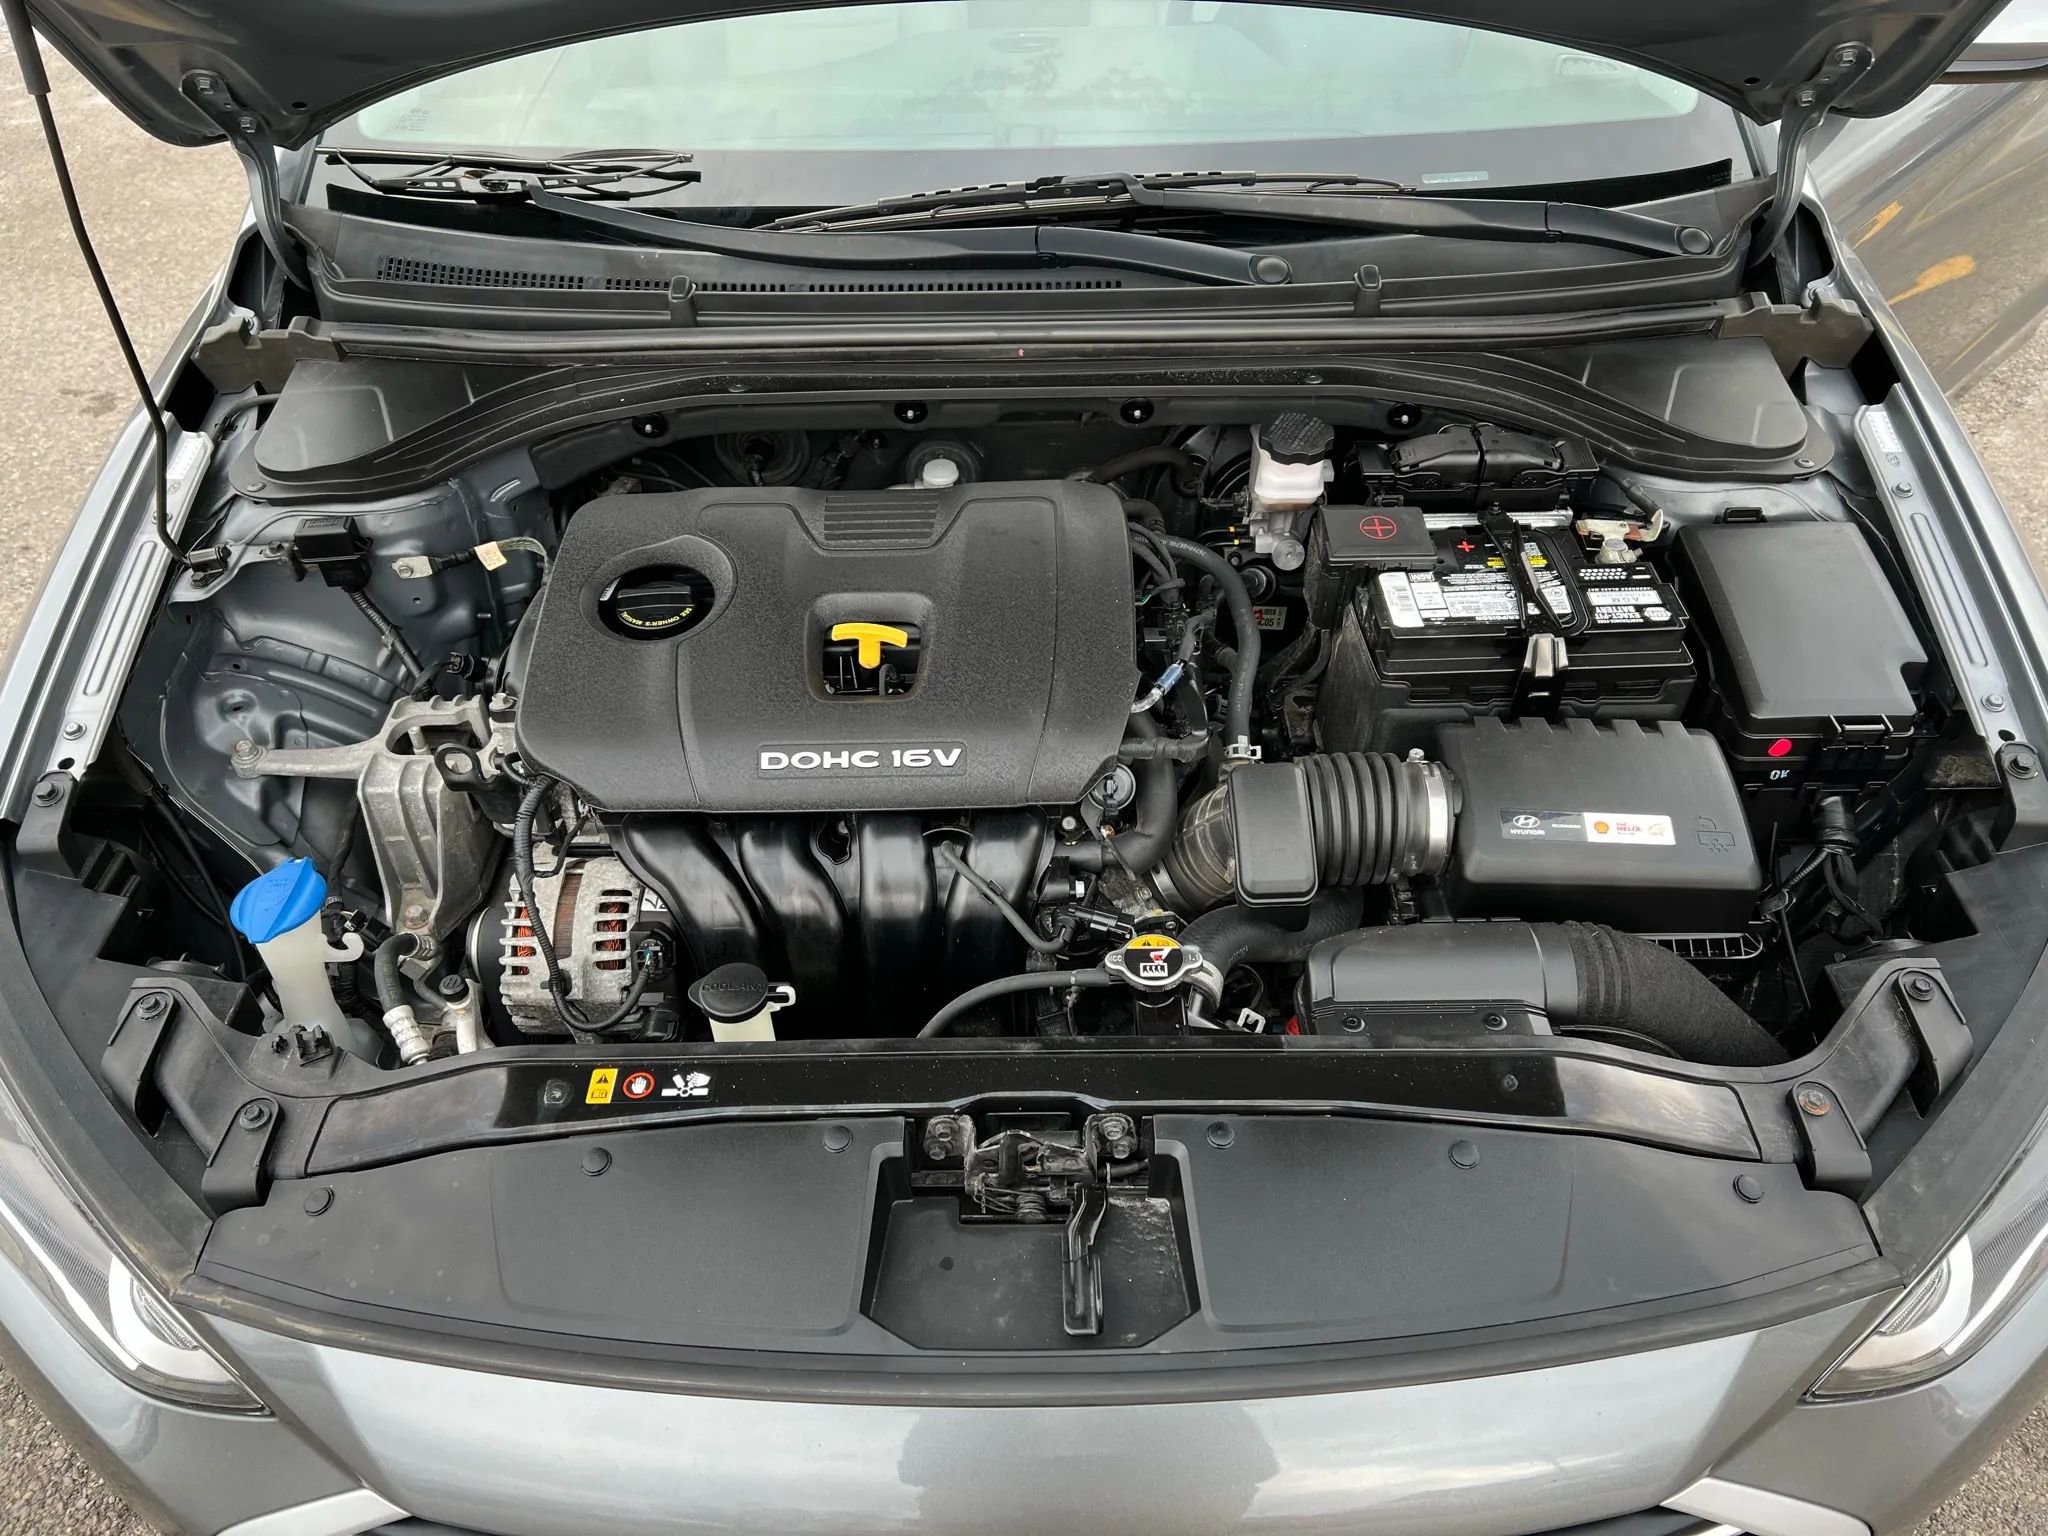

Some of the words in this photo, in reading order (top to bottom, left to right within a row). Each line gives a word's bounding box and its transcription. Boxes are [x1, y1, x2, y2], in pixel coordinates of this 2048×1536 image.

[680, 607, 693, 617] SEE
[620, 611, 643, 625] MANUAL
[645, 616, 680, 626] OWNER'S
[760, 750, 880, 770] DOHC
[892, 748, 962, 768] 16V
[1770, 770, 1790, 780] OK
[702, 982, 762, 992] COOLANT
